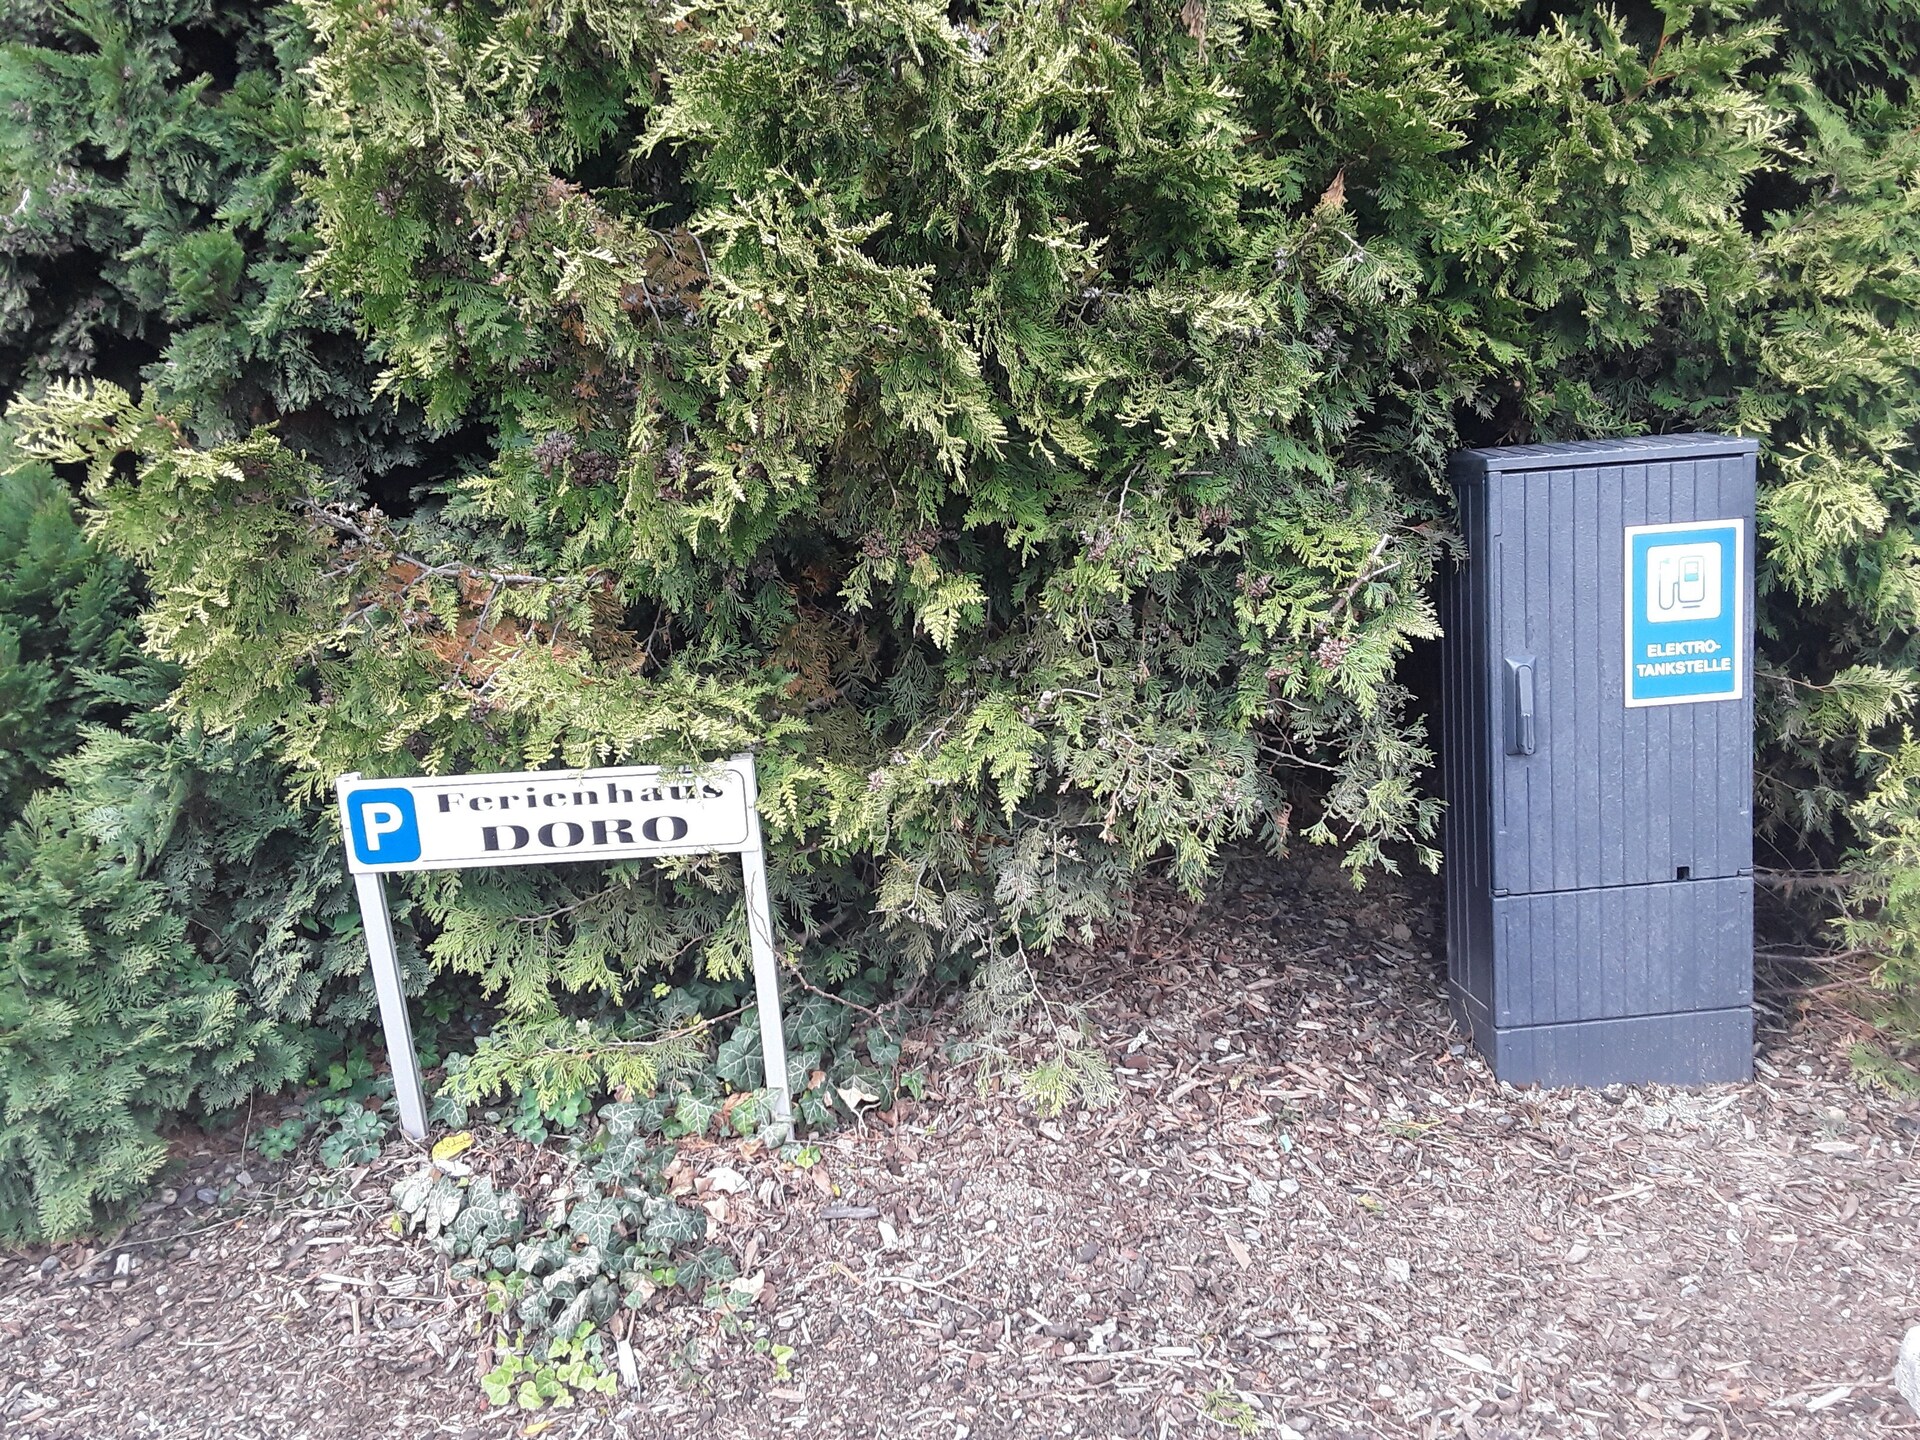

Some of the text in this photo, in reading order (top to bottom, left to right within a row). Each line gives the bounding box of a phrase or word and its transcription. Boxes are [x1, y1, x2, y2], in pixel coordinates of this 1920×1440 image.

[1647, 640, 1721, 657] ELEKTRO-
[1636, 658, 1732, 678] TANKSTELLE
[436, 782, 724, 813] Ferienhaus
[360, 802, 403, 851] P
[481, 815, 689, 851] DORO
